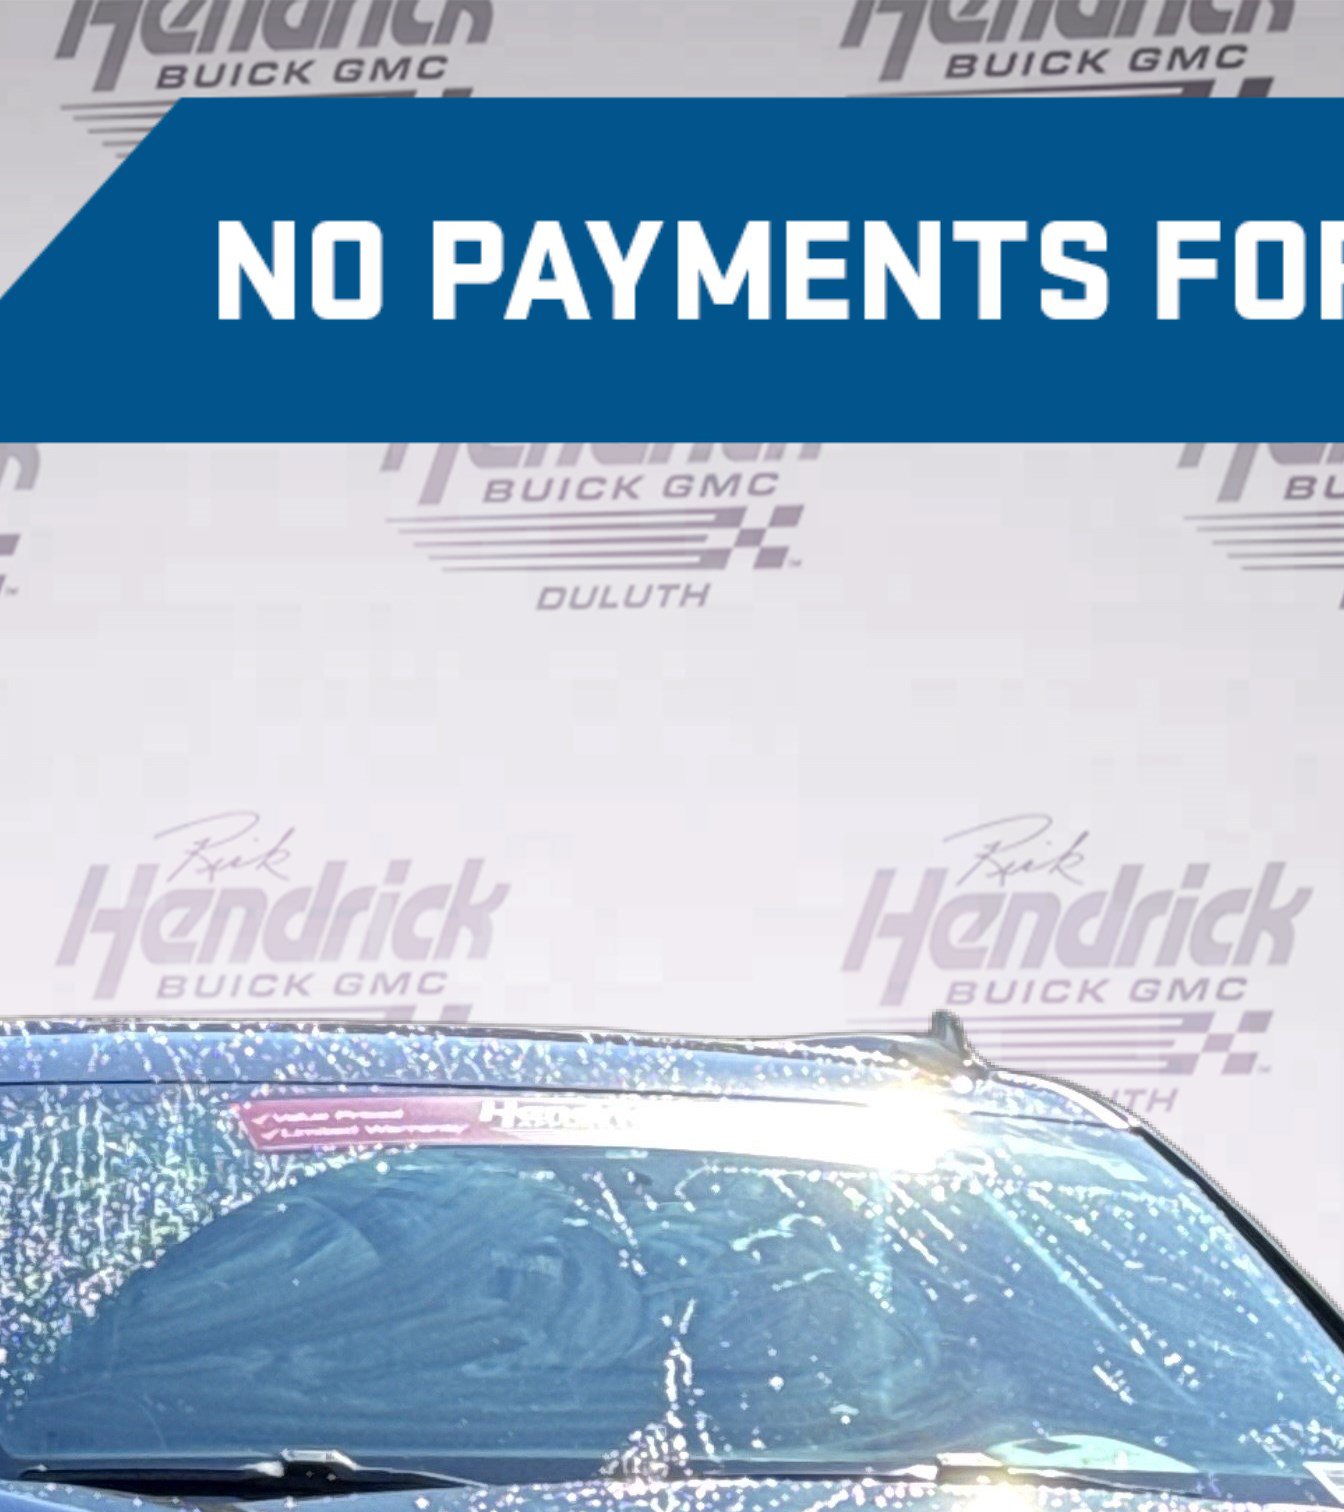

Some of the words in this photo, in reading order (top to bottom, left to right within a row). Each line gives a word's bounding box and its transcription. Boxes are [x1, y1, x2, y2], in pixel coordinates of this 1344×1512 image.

[156, 60, 316, 89] BUICK
[333, 55, 448, 84] GMC
[945, 48, 1111, 79] BUICK
[1128, 44, 1248, 72] GMC
[482, 475, 644, 504] BUICK
[662, 472, 779, 499] GMC
[535, 582, 711, 611] DULUTH
[55, 858, 511, 1001] Hendrick
[840, 861, 1314, 1007] Hendrick
[155, 971, 316, 999] BUICK
[334, 971, 448, 996] GMC
[945, 978, 1110, 1006] BUICK
[1129, 977, 1249, 1003] GMC
